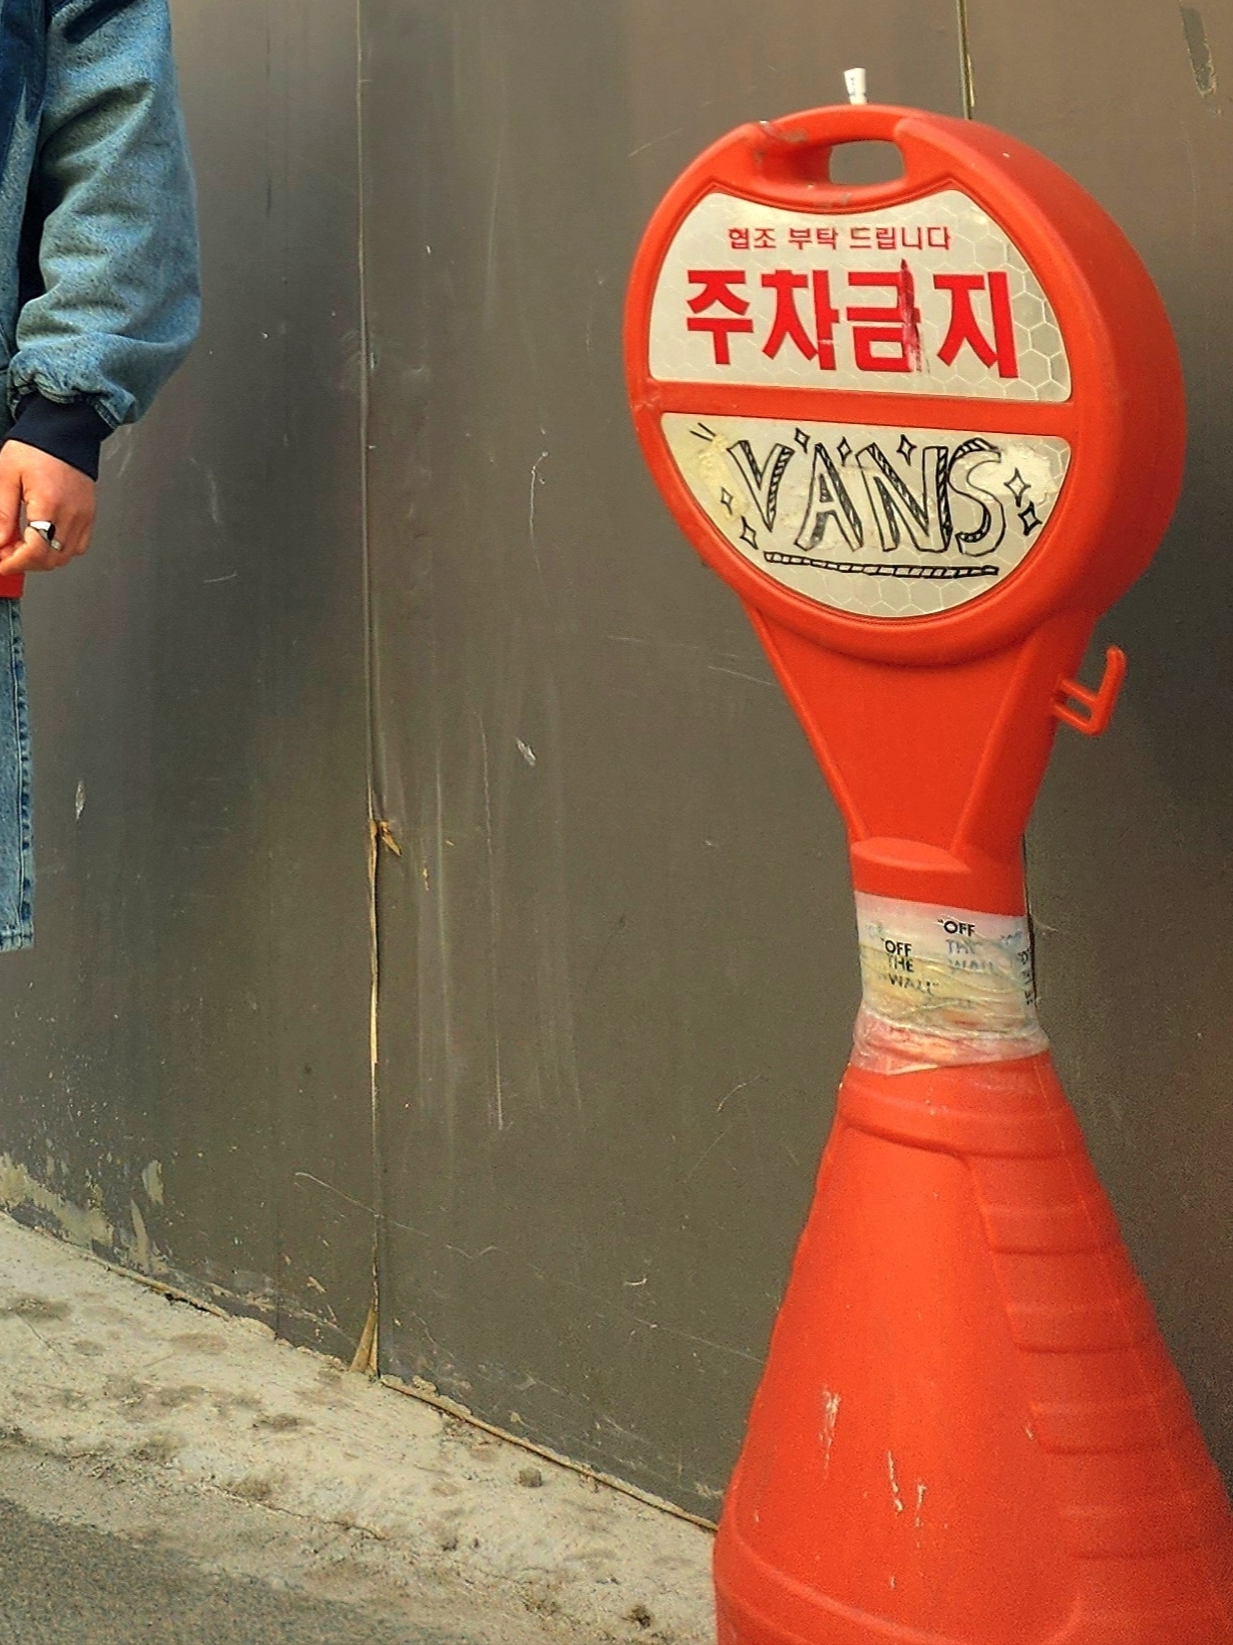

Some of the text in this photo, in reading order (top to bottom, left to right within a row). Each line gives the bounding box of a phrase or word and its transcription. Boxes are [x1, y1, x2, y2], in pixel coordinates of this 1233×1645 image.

[726, 226, 953, 252] 협조 부탁 드립니다
[686, 259, 1020, 380] 주차금지
[726, 435, 1009, 558] VANS
